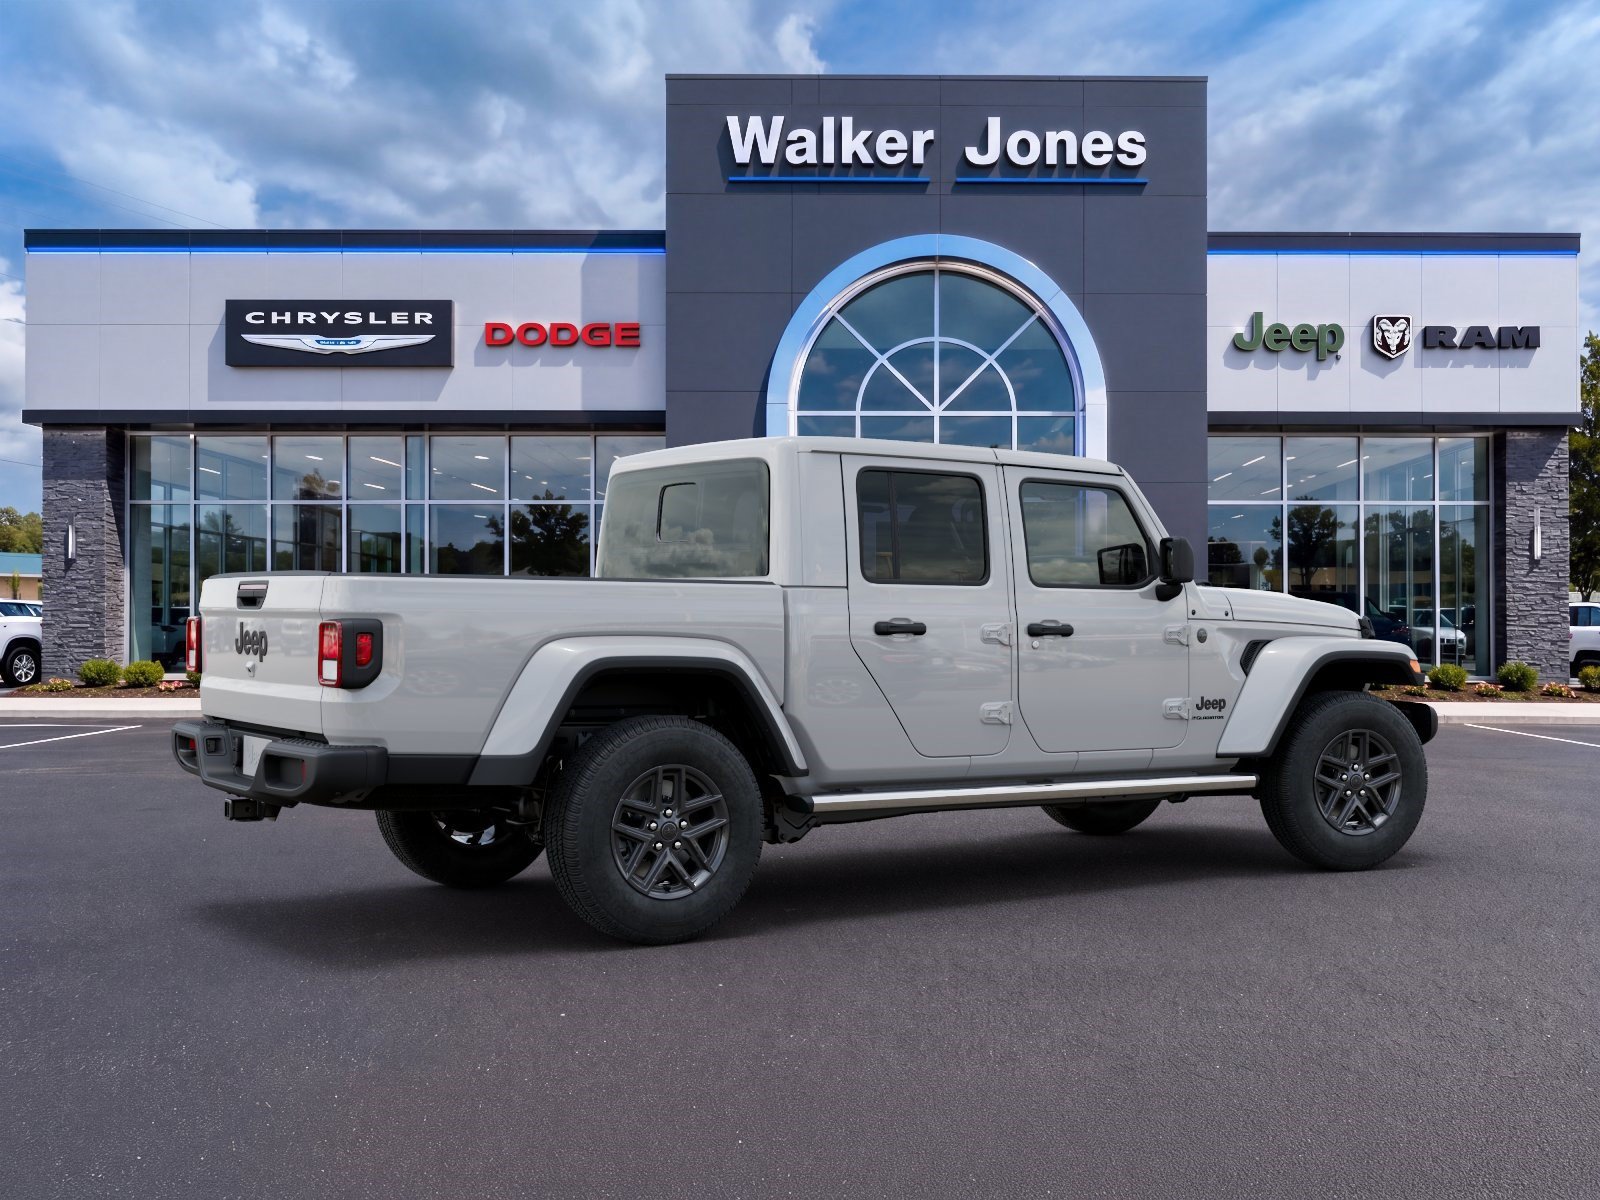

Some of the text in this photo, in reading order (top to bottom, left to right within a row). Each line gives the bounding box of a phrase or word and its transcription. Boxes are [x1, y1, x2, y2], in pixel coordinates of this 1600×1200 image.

[726, 115, 1148, 167] Walker Jones
[245, 311, 433, 325] CHRYSLER
[484, 322, 641, 347] DODGE
[1233, 311, 1345, 361] Jeep
[1422, 325, 1541, 349] RAM
[234, 621, 268, 663] Jeep
[1195, 696, 1227, 712] Jeep
